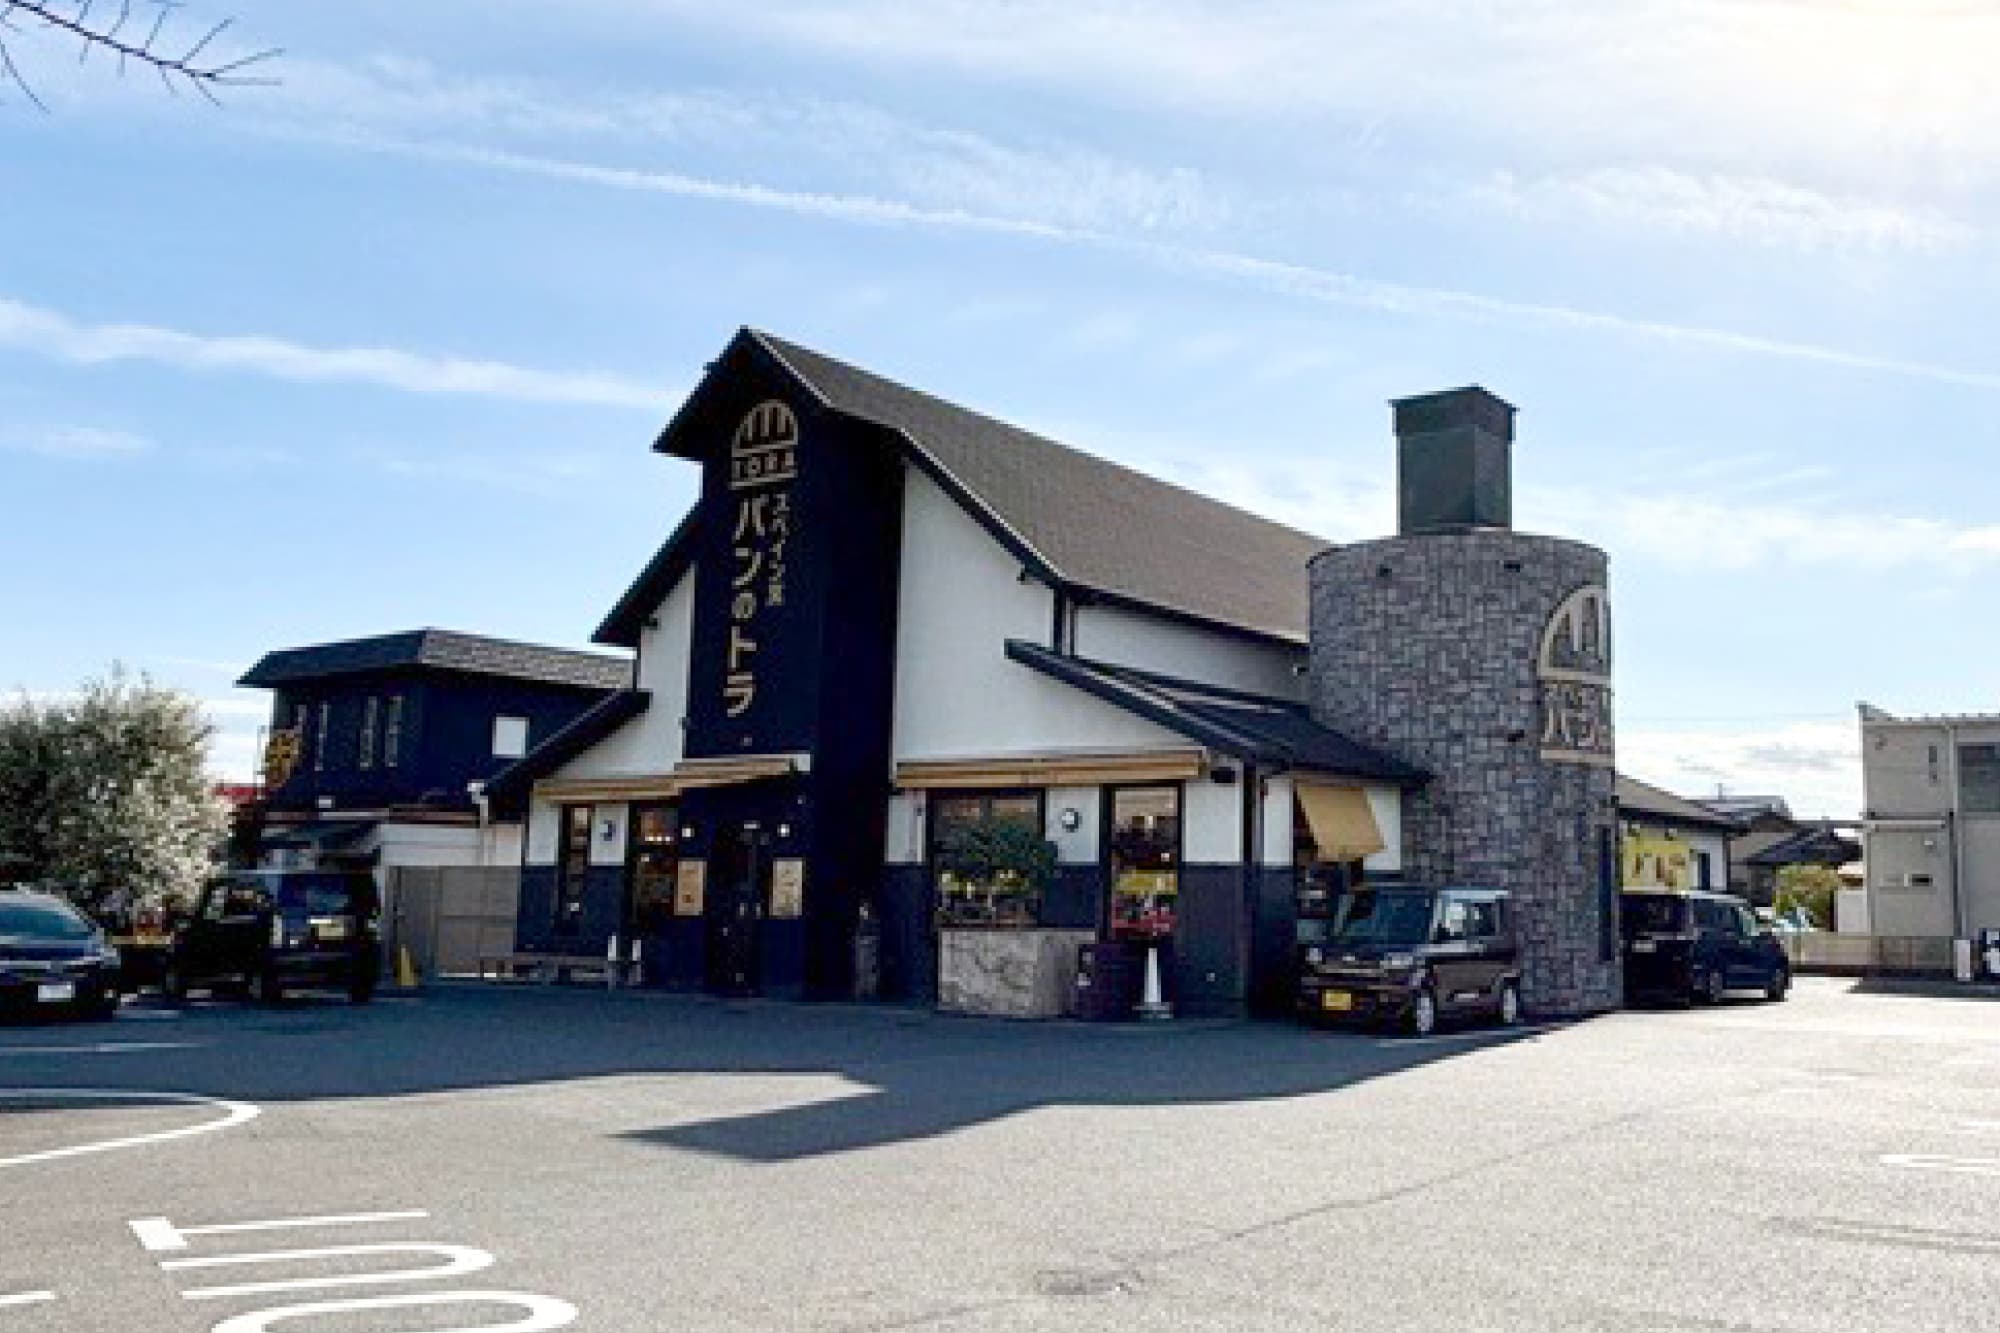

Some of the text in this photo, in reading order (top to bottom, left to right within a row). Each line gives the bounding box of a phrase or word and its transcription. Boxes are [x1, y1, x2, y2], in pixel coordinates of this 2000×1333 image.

[723, 495, 770, 718] パンのトラ
